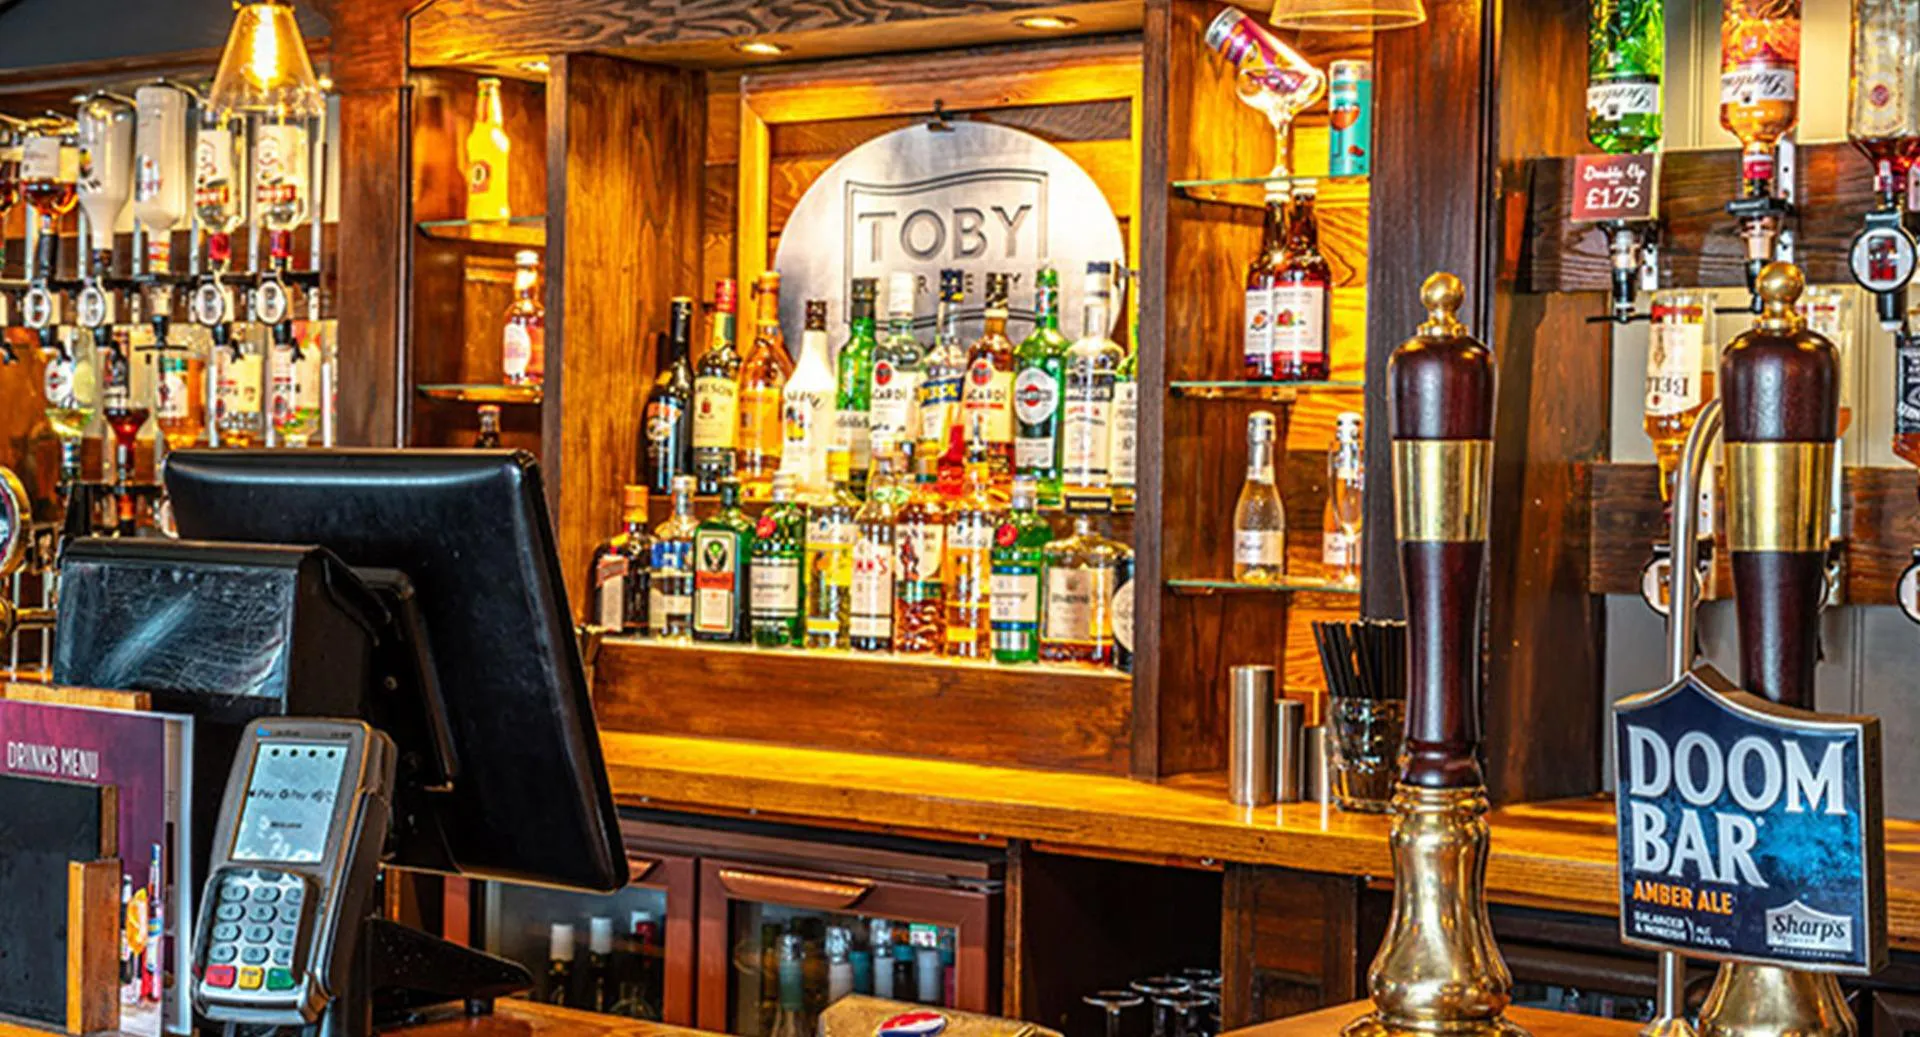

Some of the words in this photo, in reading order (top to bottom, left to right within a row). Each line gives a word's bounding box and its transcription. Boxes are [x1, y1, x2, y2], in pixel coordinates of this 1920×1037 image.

[1584, 164, 1624, 181] Double
[1627, 163, 1647, 185] Up
[1585, 186, 1640, 209] £1.75
[858, 204, 1032, 263] TOBY
[8, 741, 58, 774] DRINKS
[61, 747, 99, 779] MENU
[1627, 725, 1850, 815] DOOM
[1631, 800, 1769, 888] BAR
[1632, 879, 1694, 910] AMBER
[1697, 889, 1734, 916] ALE
[1772, 913, 1845, 942] Sharp's
